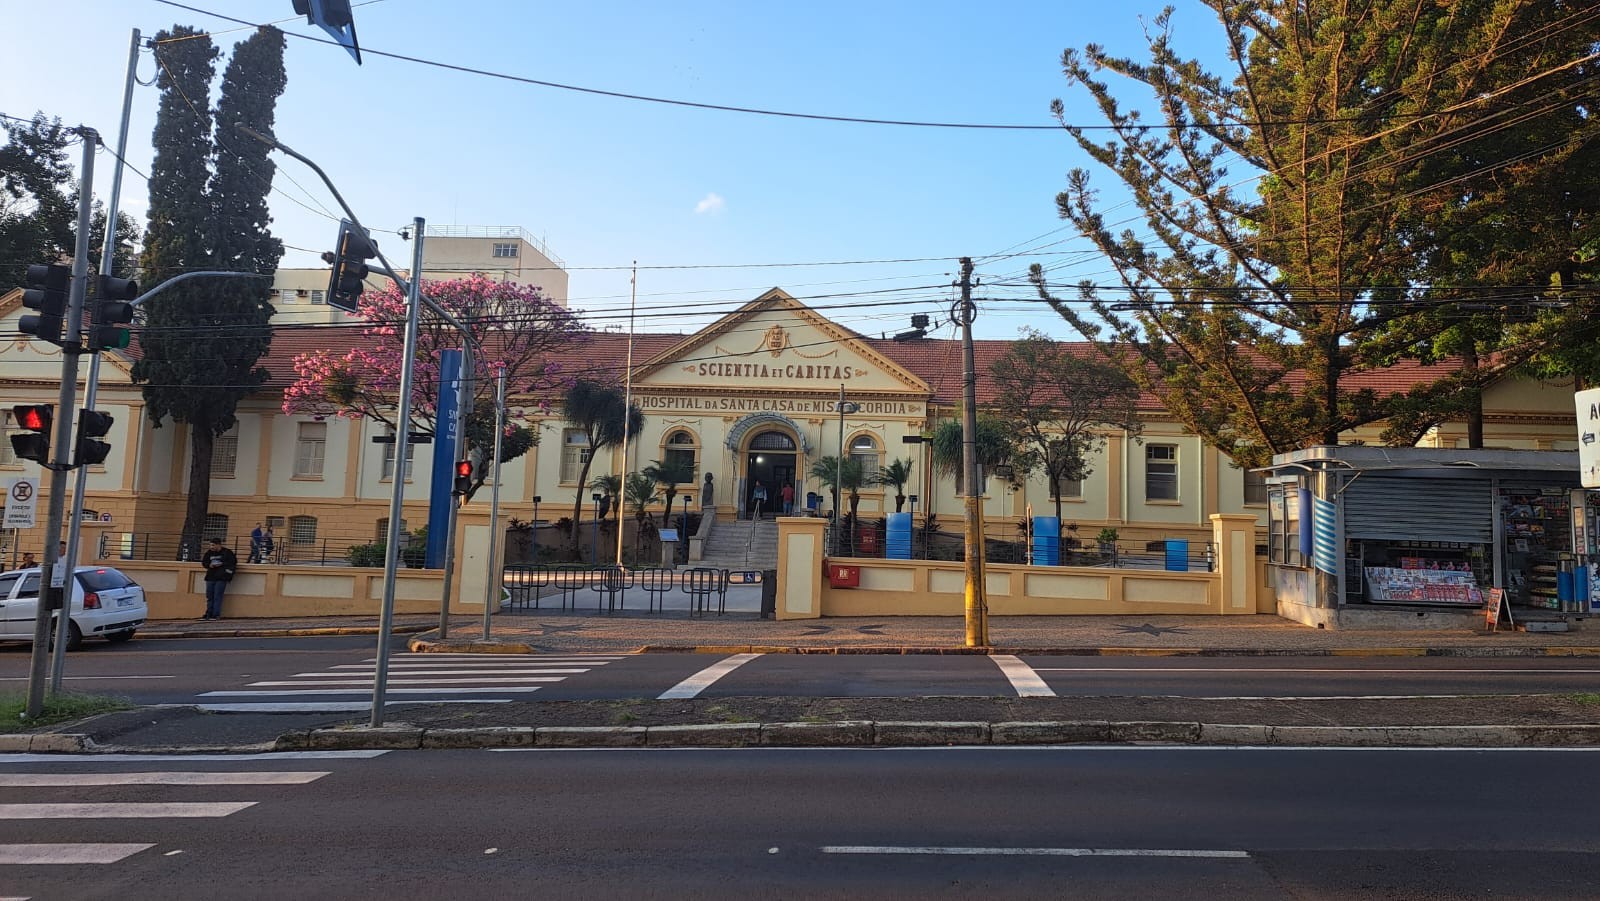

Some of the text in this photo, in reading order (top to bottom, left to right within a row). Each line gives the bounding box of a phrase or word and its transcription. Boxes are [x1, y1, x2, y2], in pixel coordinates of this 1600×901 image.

[699, 362, 852, 380] SCIENTIA ET CARITAS
[642, 396, 906, 414] HOSPITAL DA SANTA CASA DE MISCORDIA
